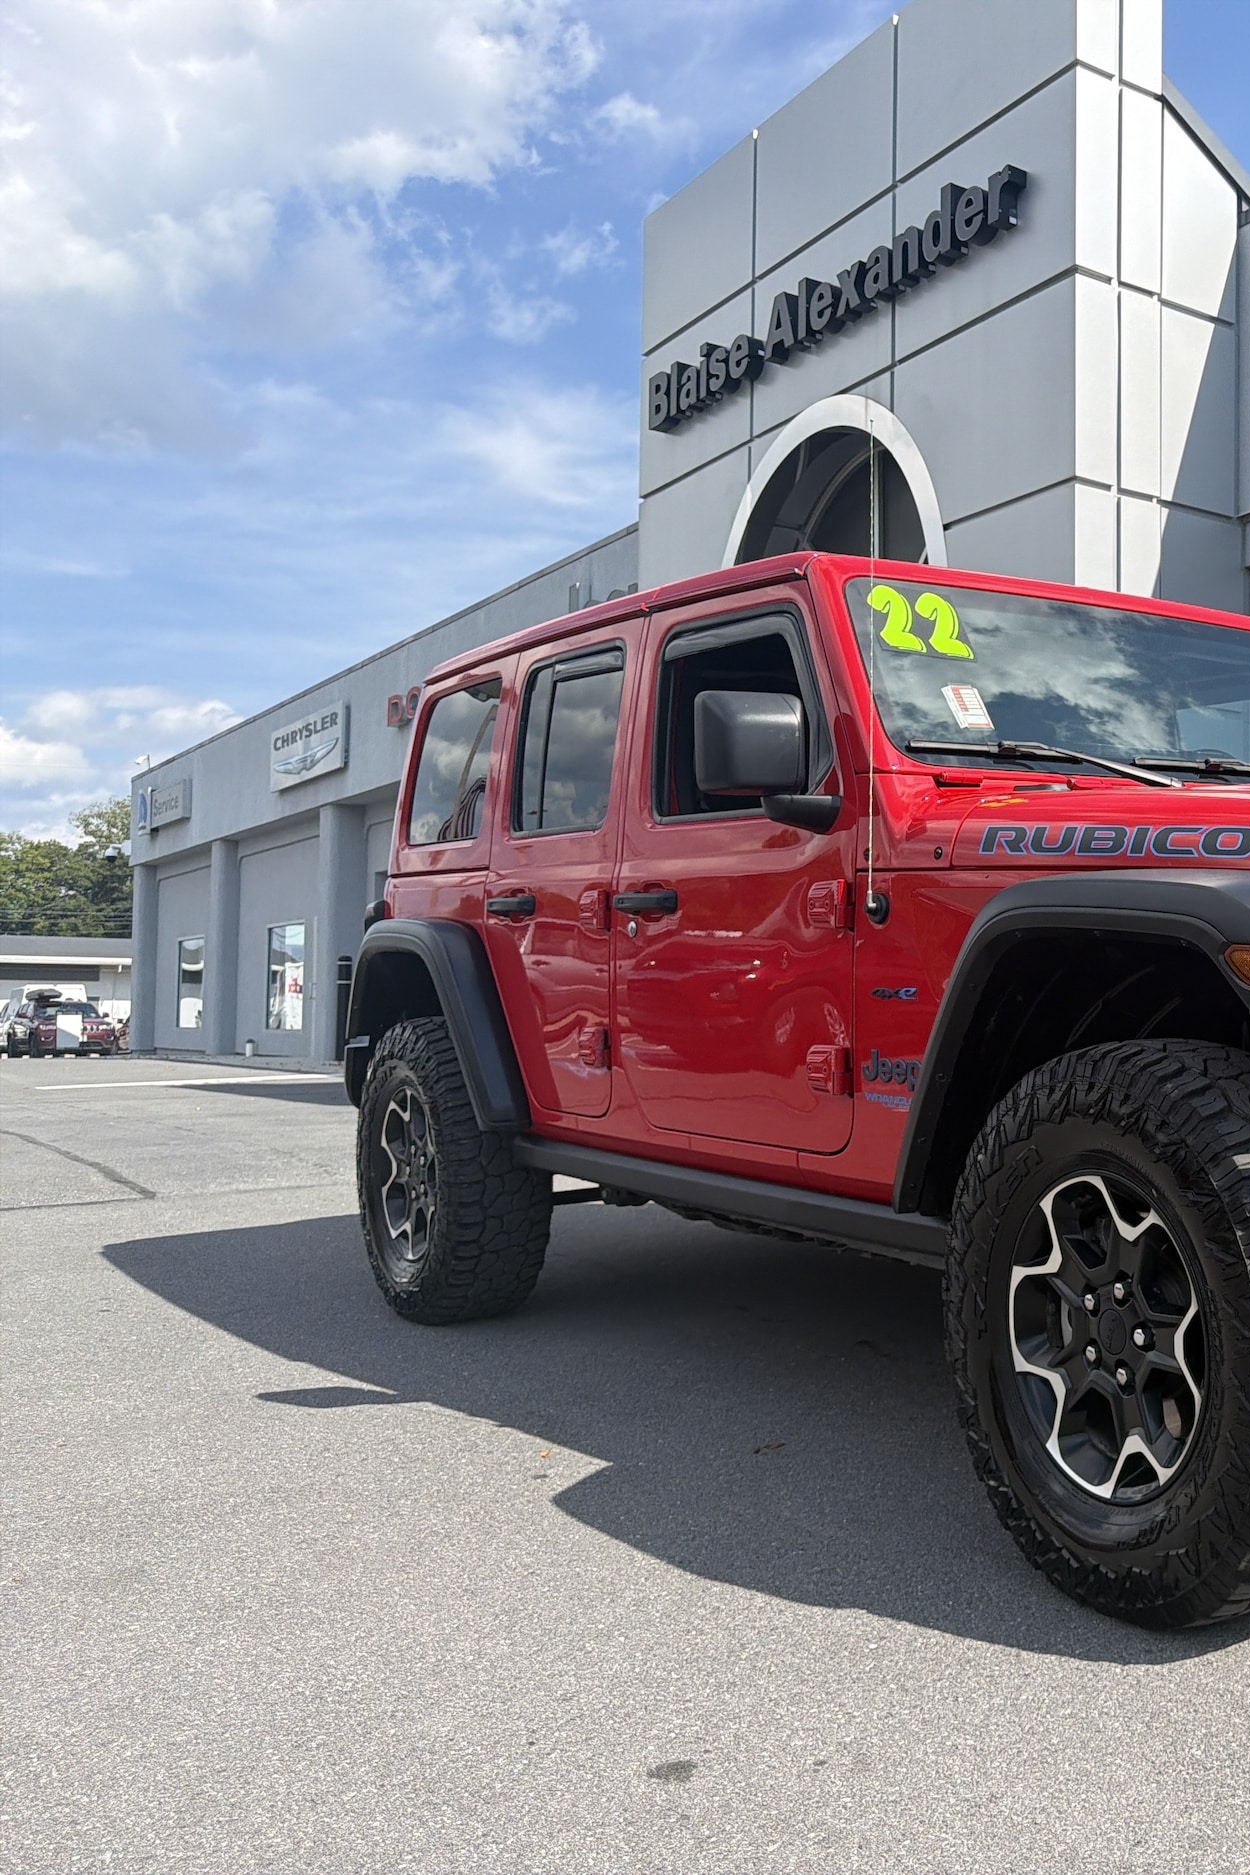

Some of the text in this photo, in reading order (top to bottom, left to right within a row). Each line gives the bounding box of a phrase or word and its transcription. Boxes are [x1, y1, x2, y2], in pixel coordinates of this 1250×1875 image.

[649, 164, 1028, 432] Blaise Alexander
[866, 584, 976, 660] 22
[273, 711, 339, 752] CHRYSLER
[153, 793, 179, 817] Service
[862, 1048, 923, 1092] Jeep
